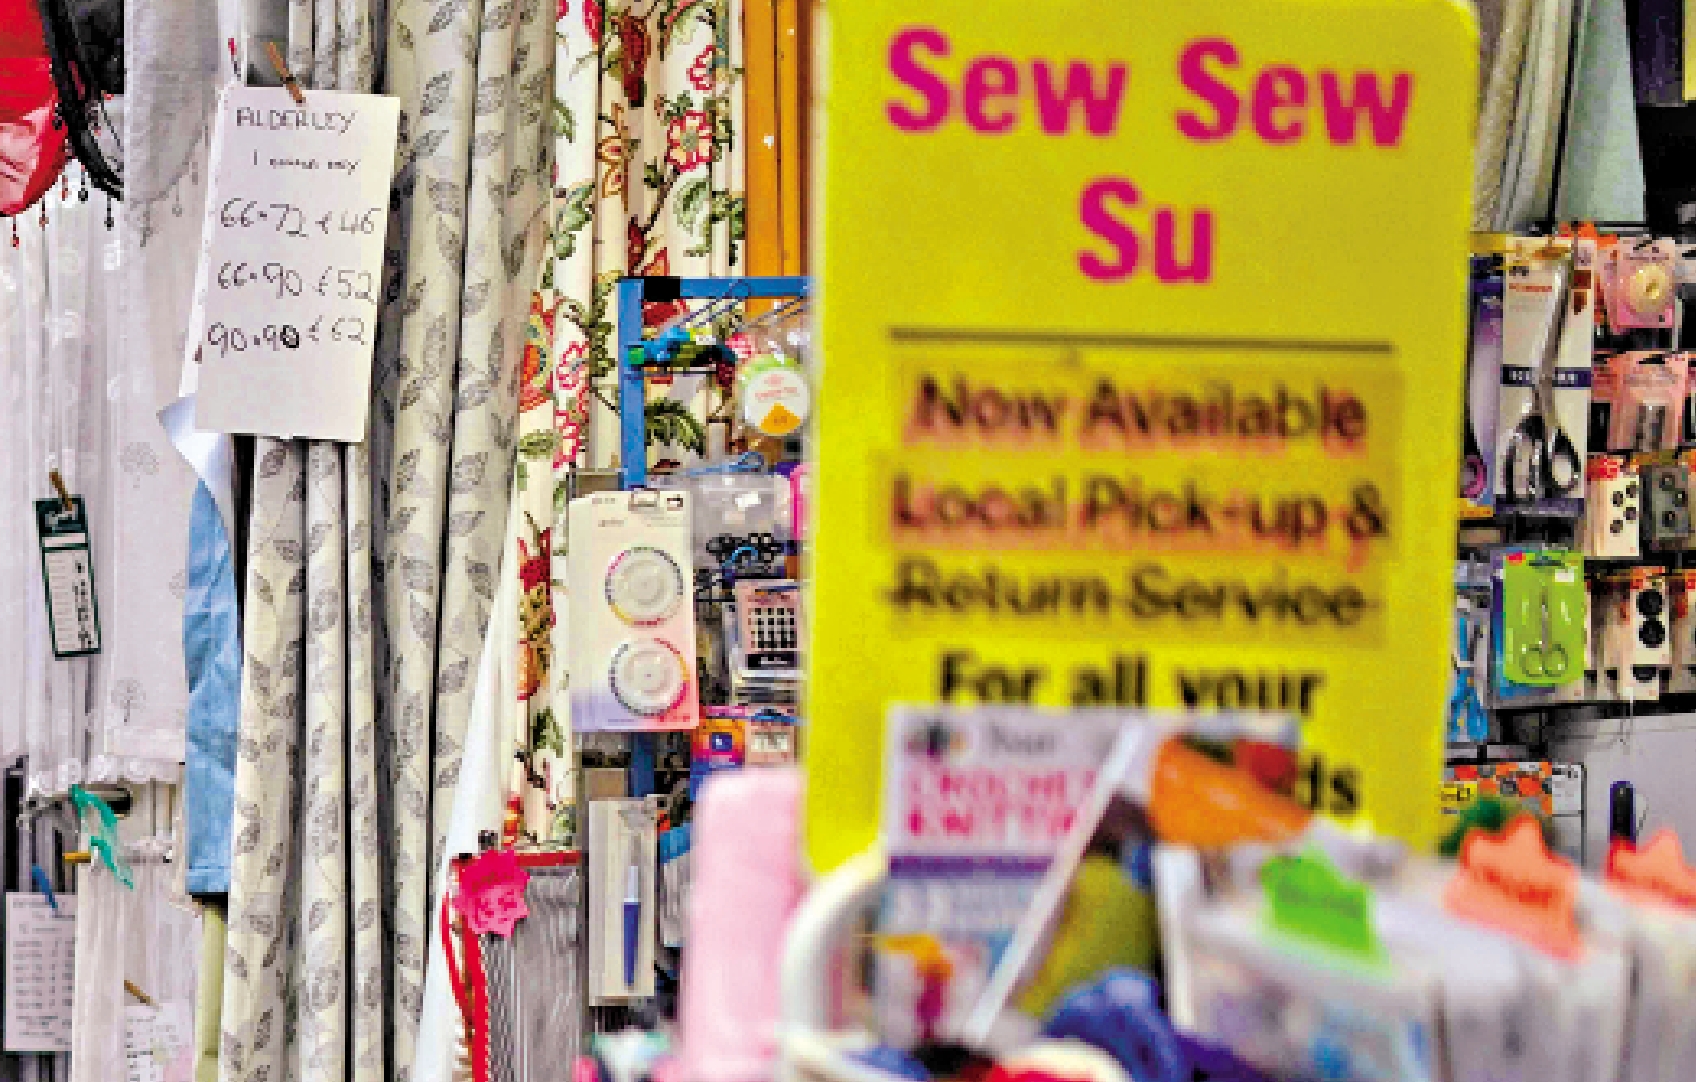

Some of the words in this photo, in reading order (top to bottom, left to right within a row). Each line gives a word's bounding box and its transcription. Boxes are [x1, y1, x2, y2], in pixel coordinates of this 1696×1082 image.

[885, 24, 1129, 137] Sew
[1174, 35, 1415, 149] Sew
[1075, 175, 1215, 286] Su
[910, 376, 1057, 431] Now
[1083, 376, 1368, 440] Available
[891, 474, 1067, 530] Local
[1079, 473, 1330, 548] Pick-up
[1345, 480, 1390, 538] &
[892, 554, 1112, 614] Return
[1128, 561, 1367, 627] Service
[937, 650, 1046, 703] For
[1069, 651, 1151, 704] all
[1173, 668, 1327, 718] your
